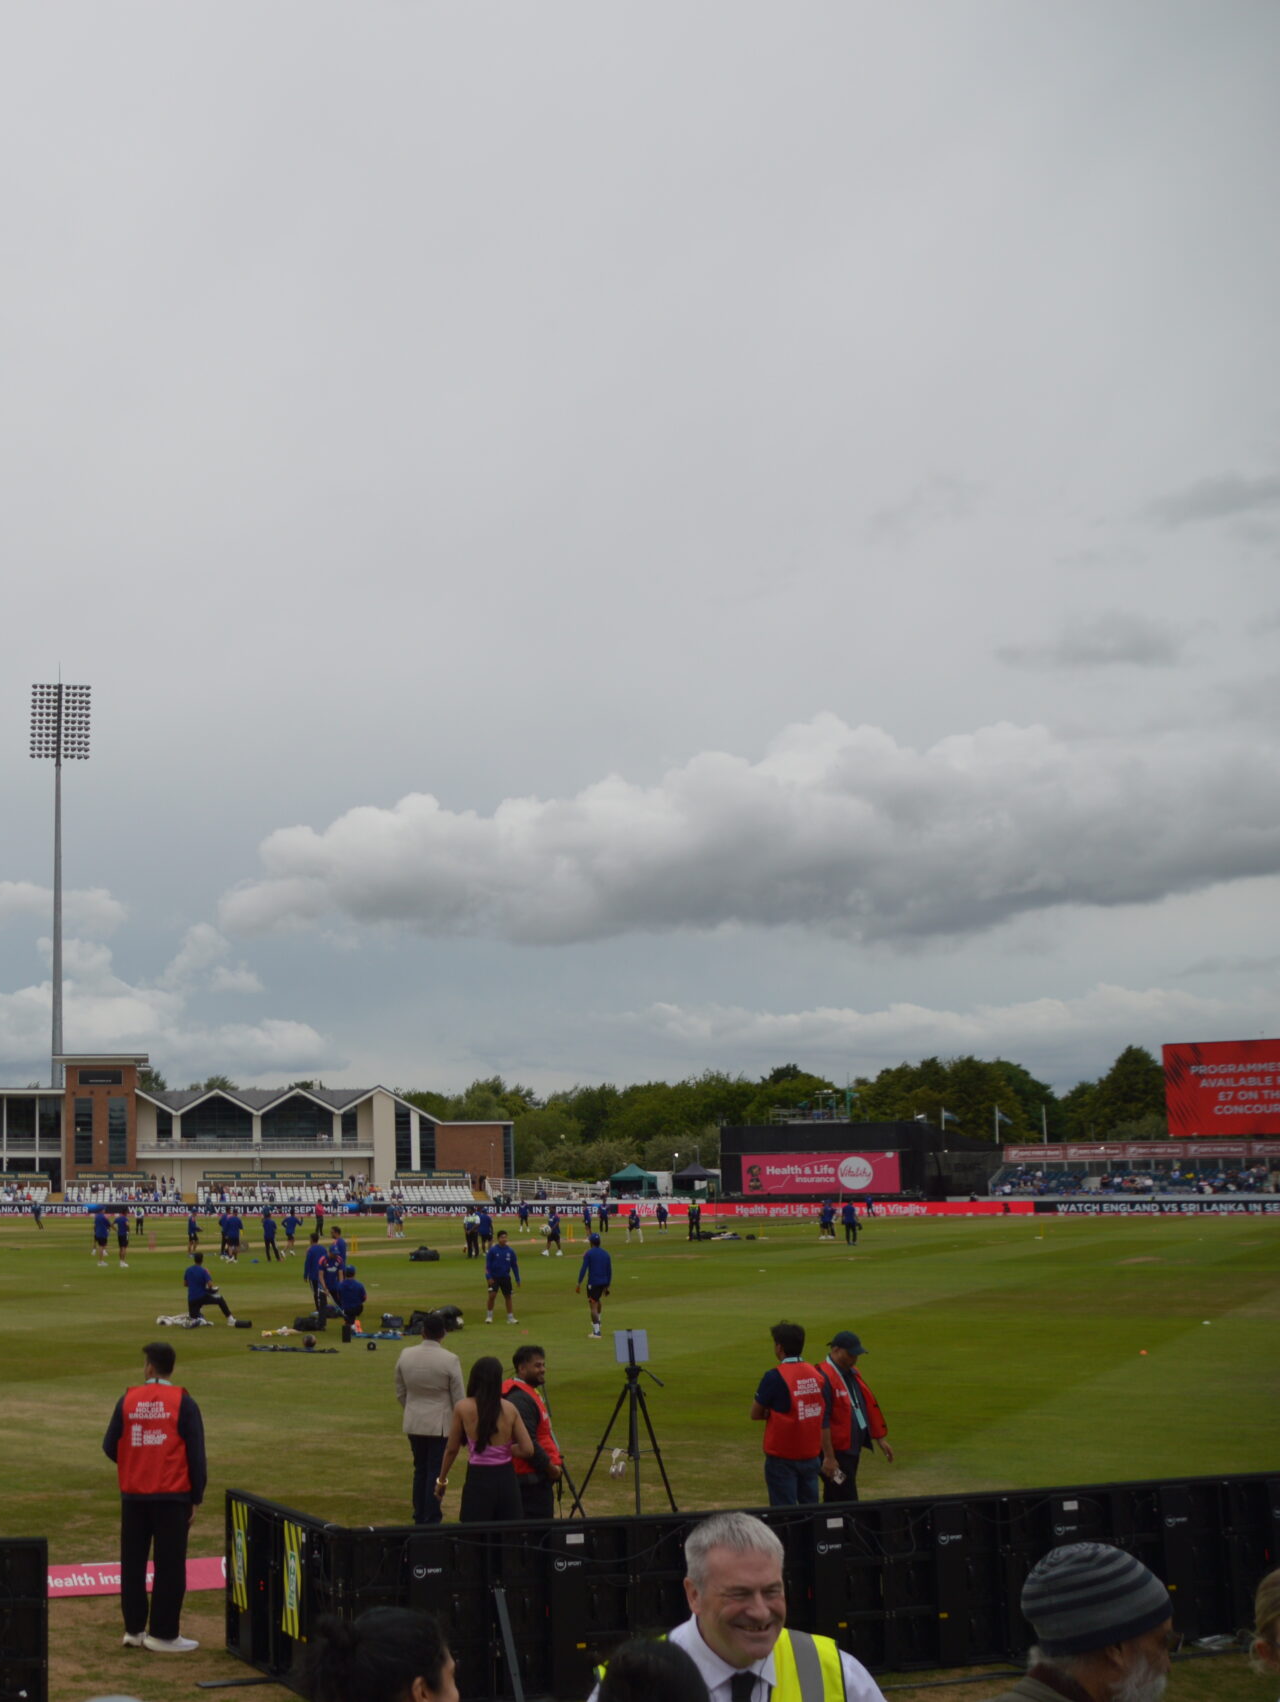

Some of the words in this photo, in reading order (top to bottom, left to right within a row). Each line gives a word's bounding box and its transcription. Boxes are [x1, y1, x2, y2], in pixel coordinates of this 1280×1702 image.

[1200, 1076, 1273, 1088] AVAILABLE
[1237, 1090, 1258, 1100] ON
[766, 1165, 802, 1175] Health
[813, 1165, 835, 1175] Life
[795, 1175, 836, 1184] insurance
[735, 1204, 768, 1215] Health
[770, 1204, 789, 1214] and
[791, 1204, 811, 1214] Life
[889, 1204, 927, 1215] Vitality
[1057, 1203, 1100, 1212] WATCH
[1102, 1203, 1160, 1212] ENGLAND
[1162, 1203, 1178, 1212] VS
[1181, 1203, 1200, 1212] SRI
[1203, 1203, 1245, 1212] LANKA
[1249, 1203, 1262, 1212] IN
